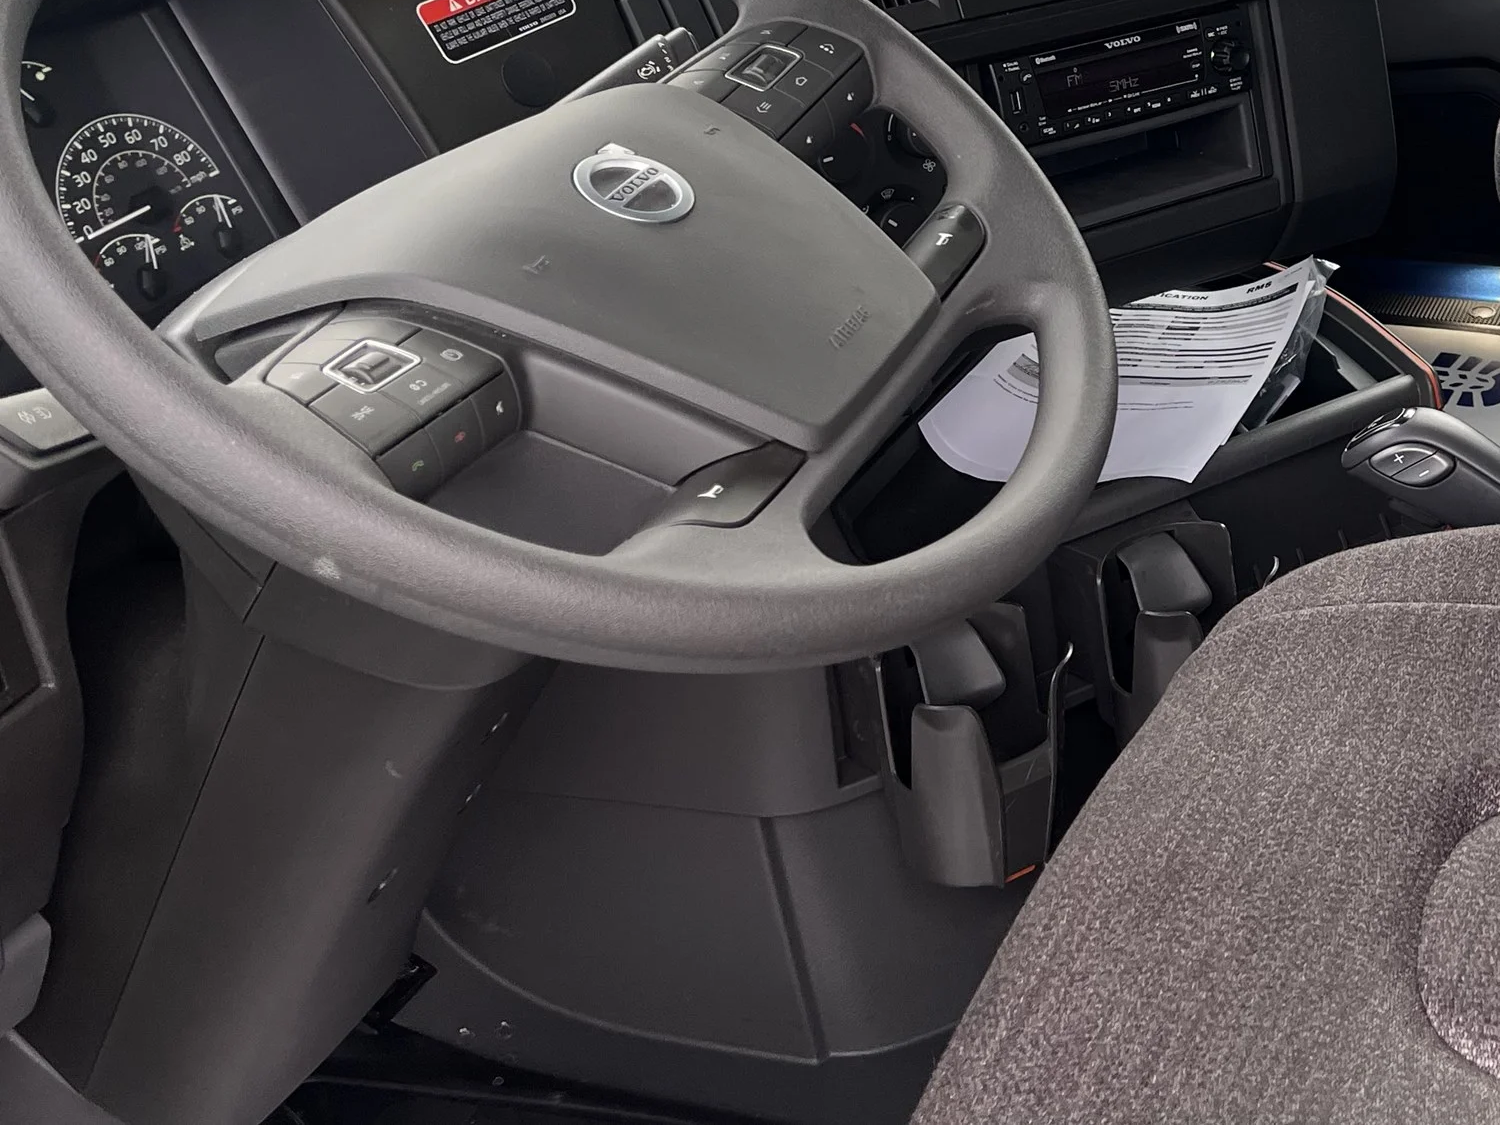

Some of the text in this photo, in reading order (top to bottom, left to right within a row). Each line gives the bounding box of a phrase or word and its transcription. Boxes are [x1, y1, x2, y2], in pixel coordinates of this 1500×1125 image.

[1104, 36, 1141, 49] VOLVO
[98, 132, 116, 148] 50
[124, 129, 142, 144] 60
[150, 136, 168, 151] 70
[81, 149, 97, 163] 40
[173, 150, 191, 165] 80
[72, 171, 91, 187] 30
[609, 167, 660, 202] VOLVO
[72, 198, 91, 214] 20
[116, 245, 127, 255] 90
[1158, 293, 1209, 301] ICATION
[829, 305, 870, 349] AIRBAG
